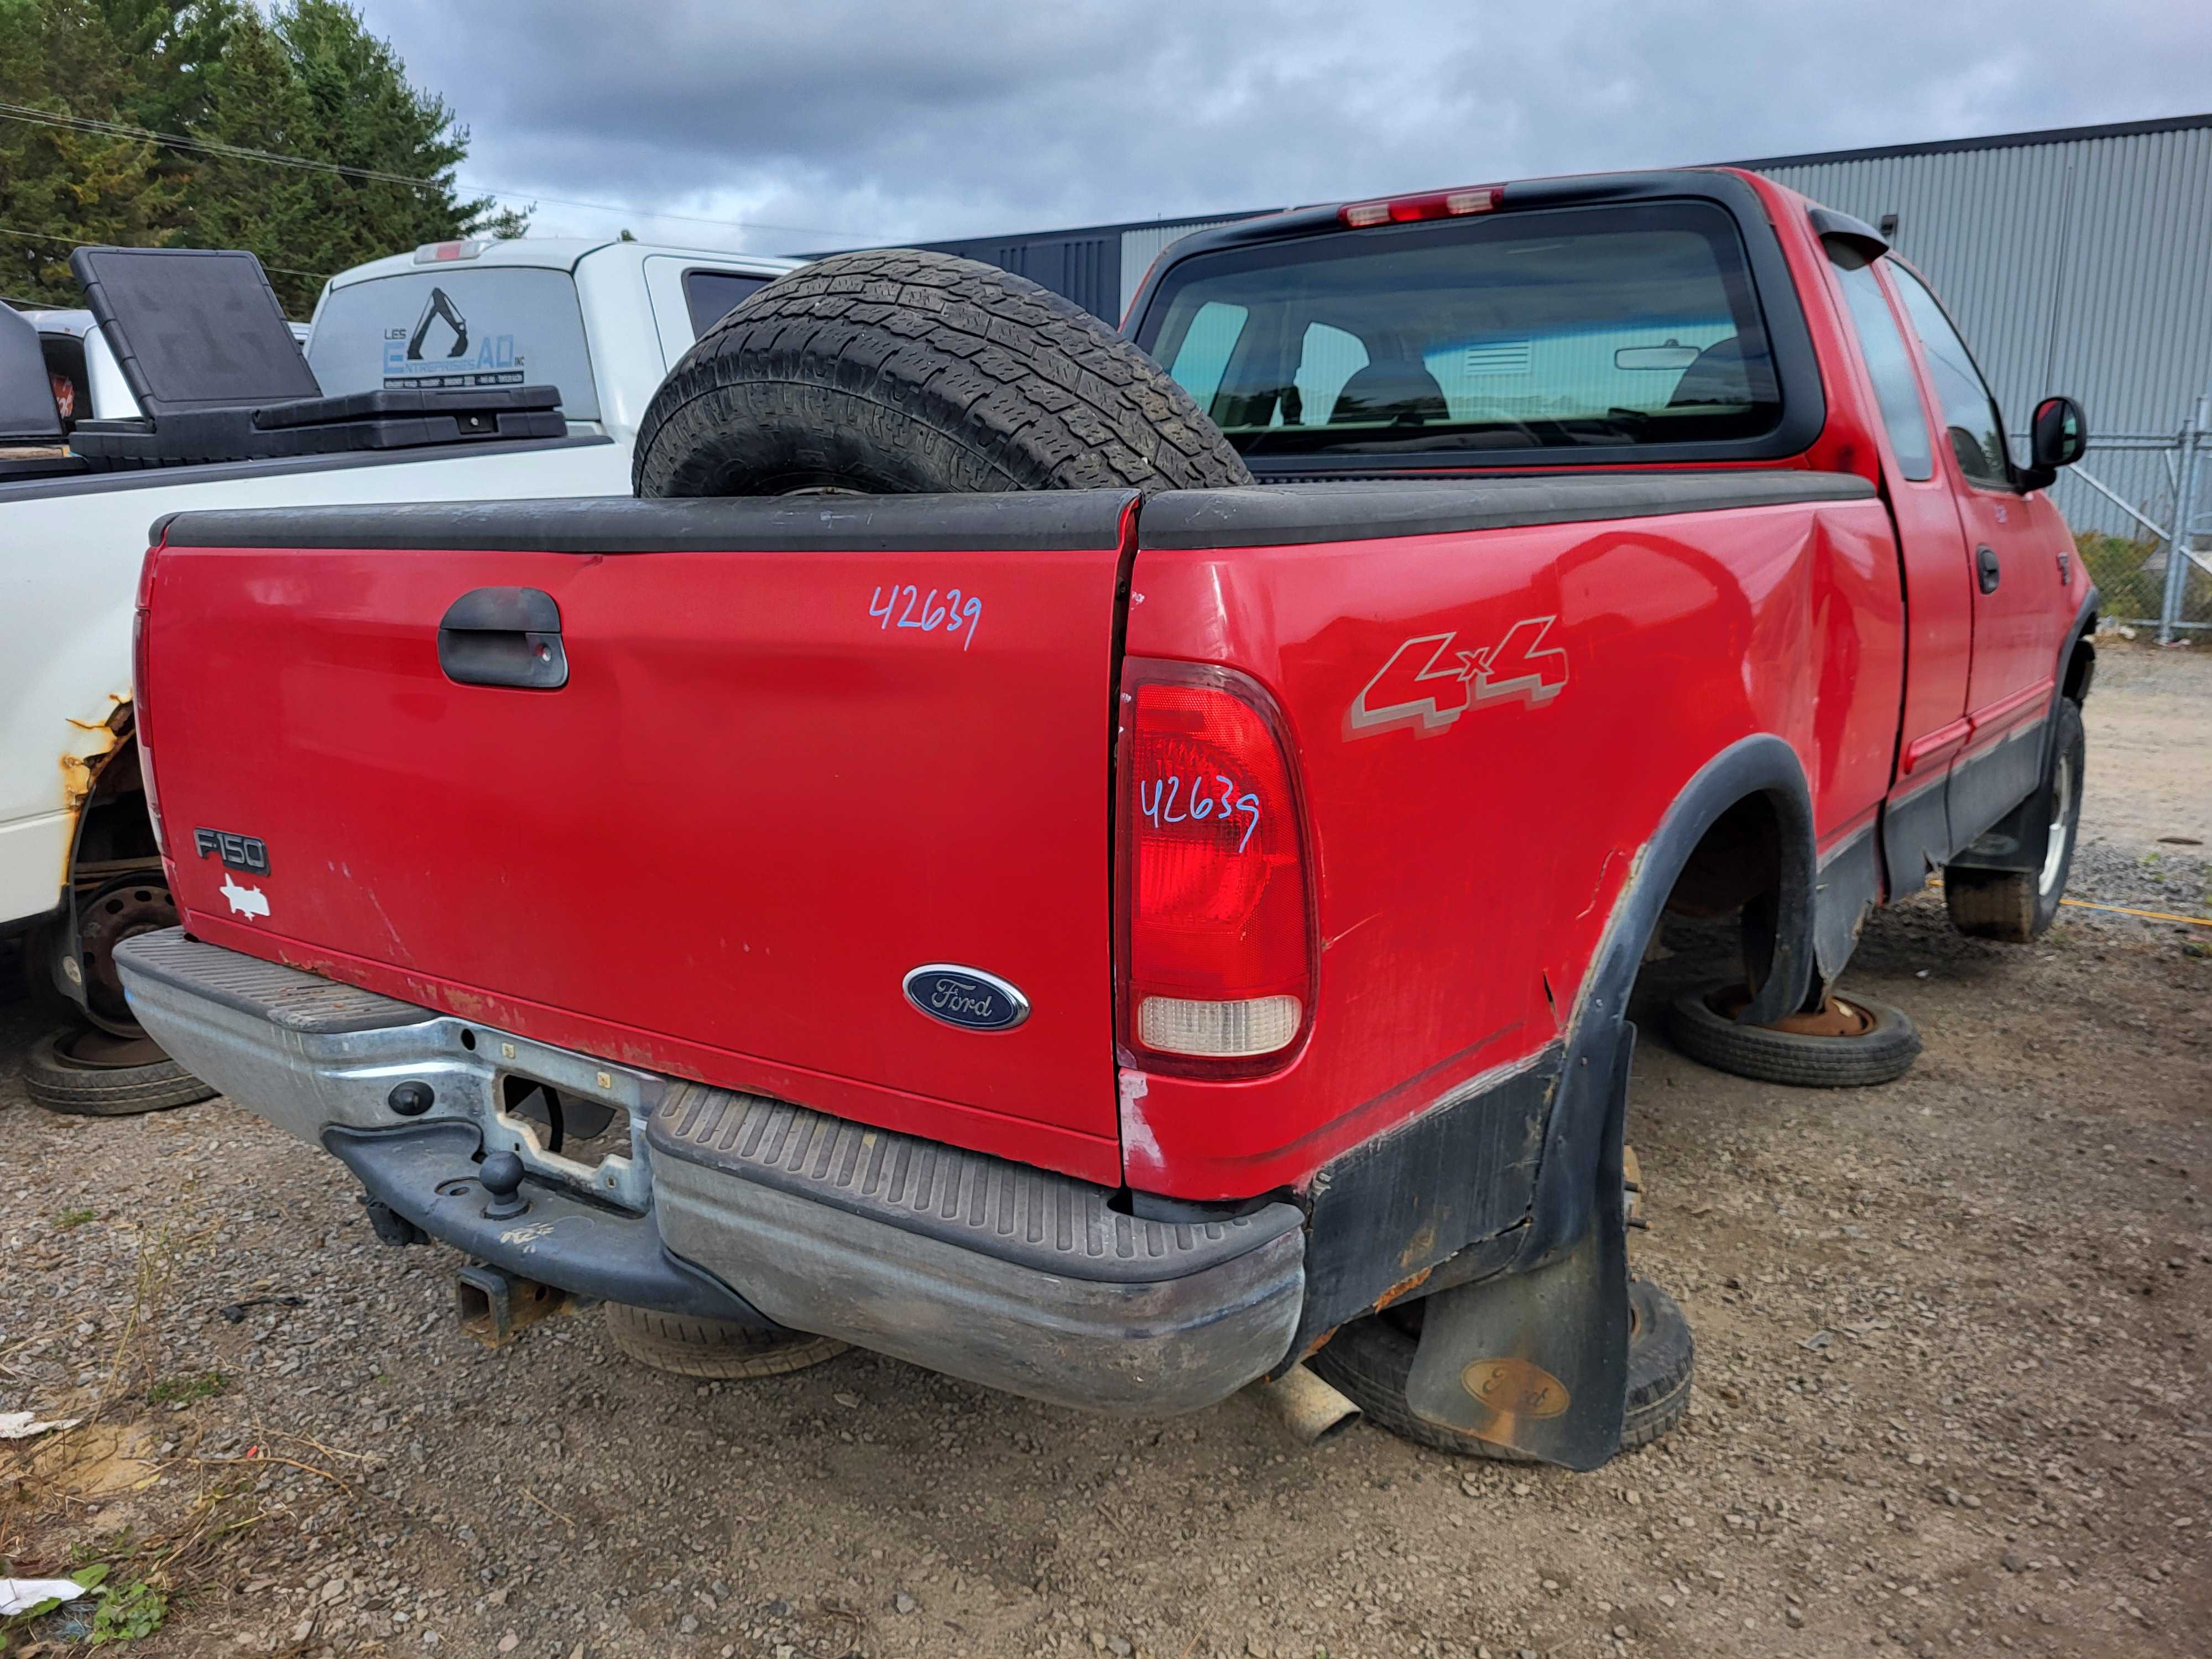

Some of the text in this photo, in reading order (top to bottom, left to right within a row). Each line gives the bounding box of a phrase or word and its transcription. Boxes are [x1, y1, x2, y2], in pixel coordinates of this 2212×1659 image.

[384, 328, 407, 340] LES
[869, 585, 982, 651] 42639
[1141, 775, 1260, 853] 42639
[931, 978, 993, 1018] Ford
